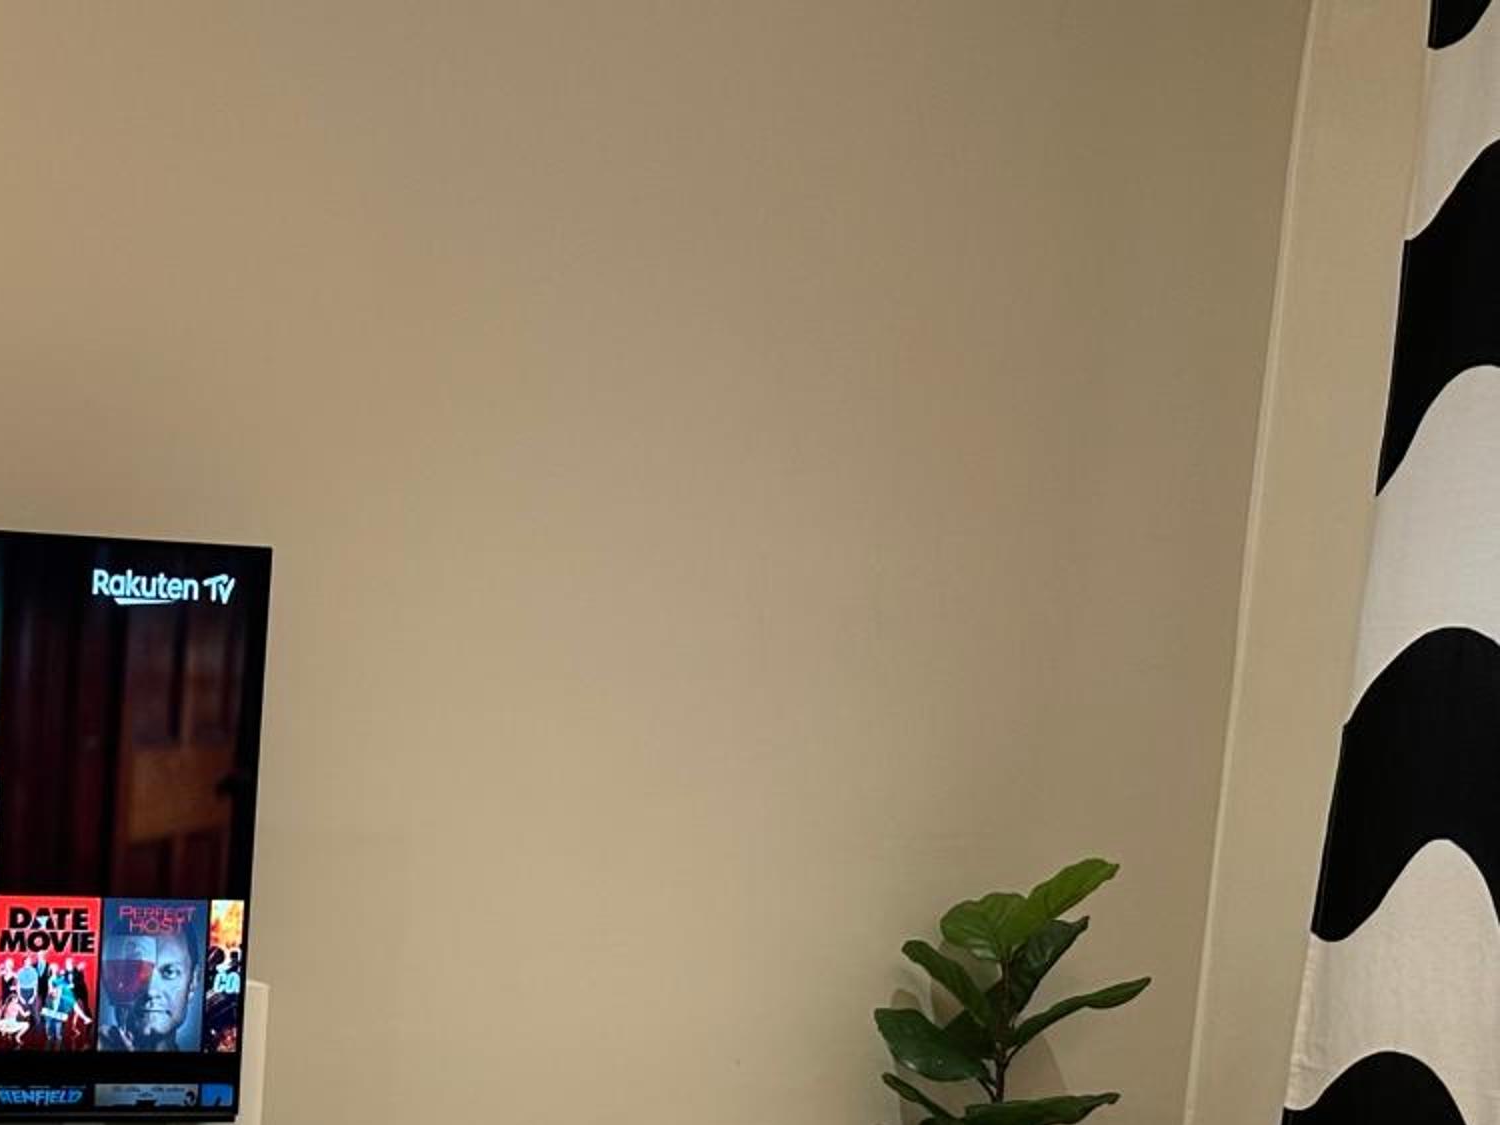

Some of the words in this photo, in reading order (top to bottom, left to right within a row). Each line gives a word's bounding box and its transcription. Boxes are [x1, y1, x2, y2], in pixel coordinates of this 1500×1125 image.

[92, 568, 199, 601] Rakuten
[202, 573, 236, 605] TV
[8, 906, 89, 930] DATE
[129, 916, 186, 934] HOST
